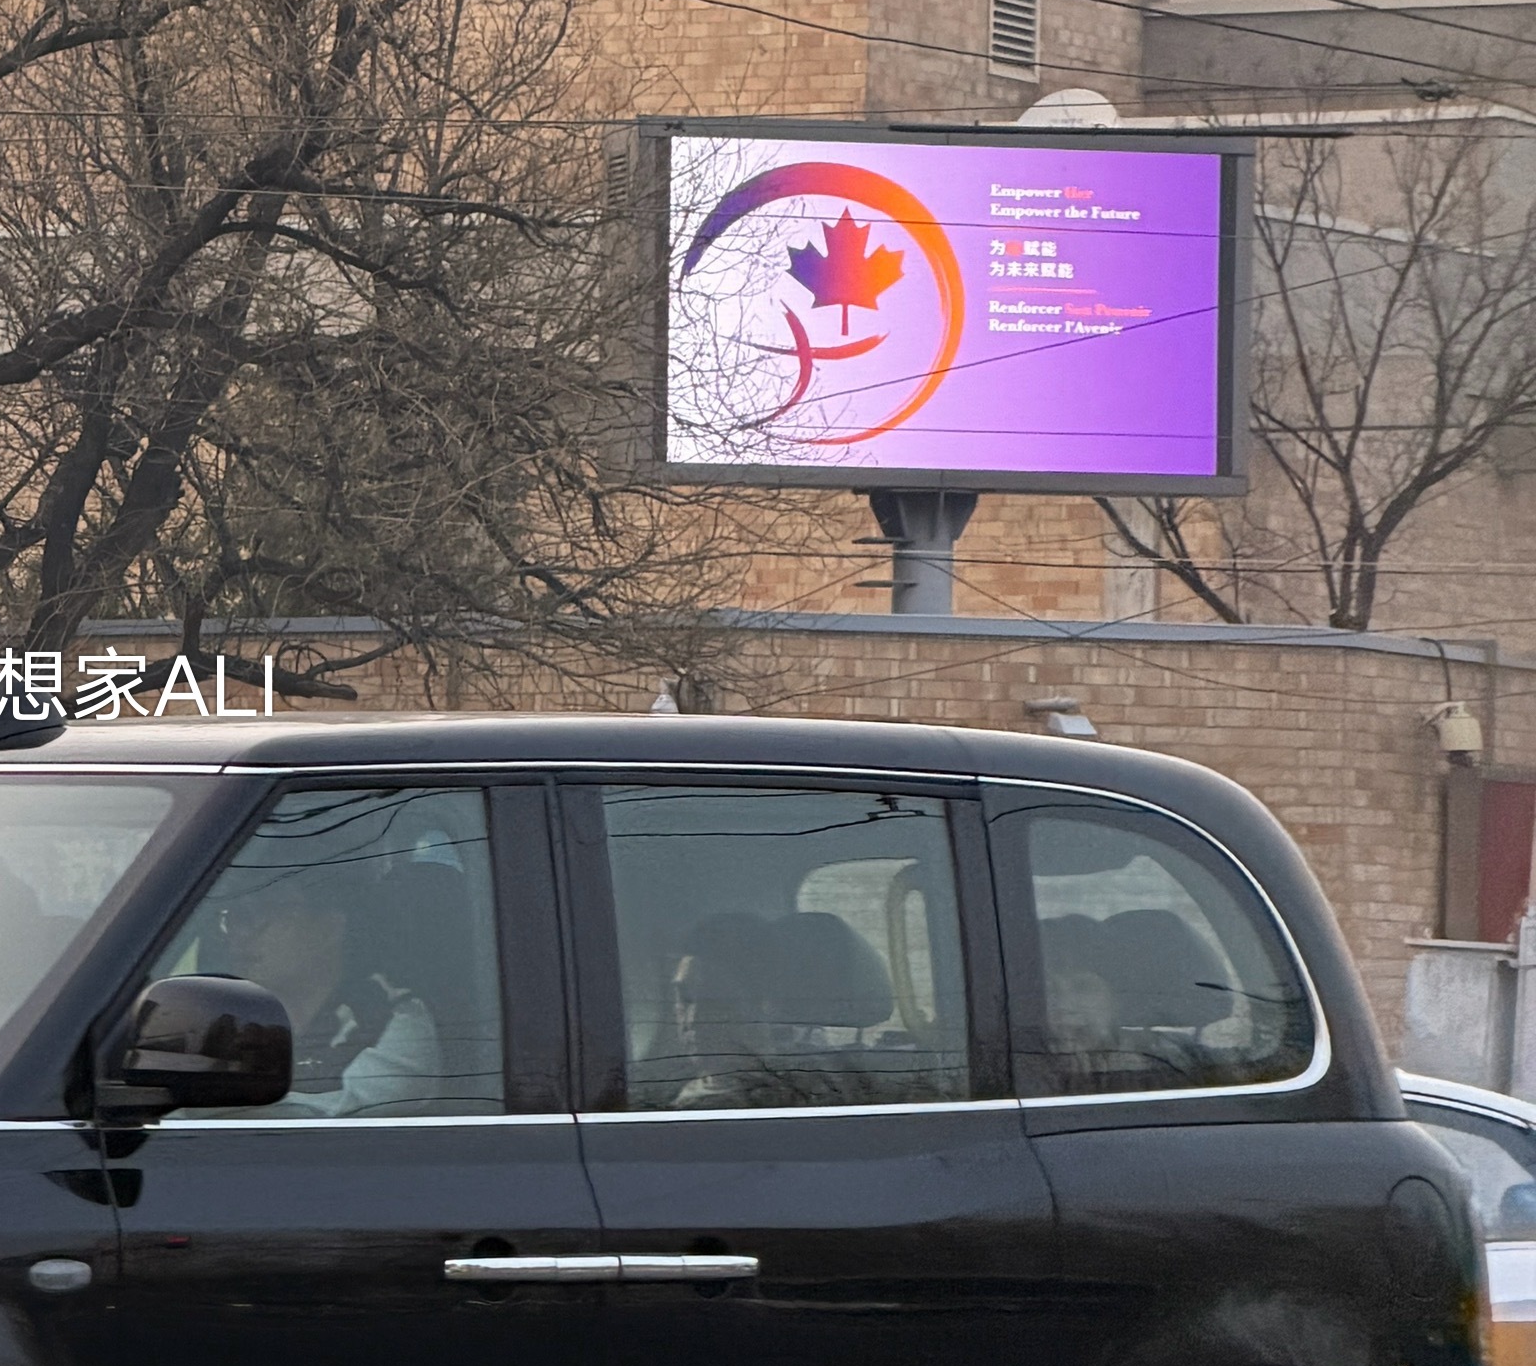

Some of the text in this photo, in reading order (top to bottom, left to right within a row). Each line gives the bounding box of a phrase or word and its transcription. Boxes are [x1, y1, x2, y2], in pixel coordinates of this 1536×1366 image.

[989, 184, 1062, 200] Empower
[989, 203, 1141, 221] Empower the Future
[989, 239, 1057, 257] 为赋能
[988, 261, 1074, 279] 为未来赋能
[988, 301, 1063, 315] Renforcer
[988, 318, 1062, 333] Renforcer
